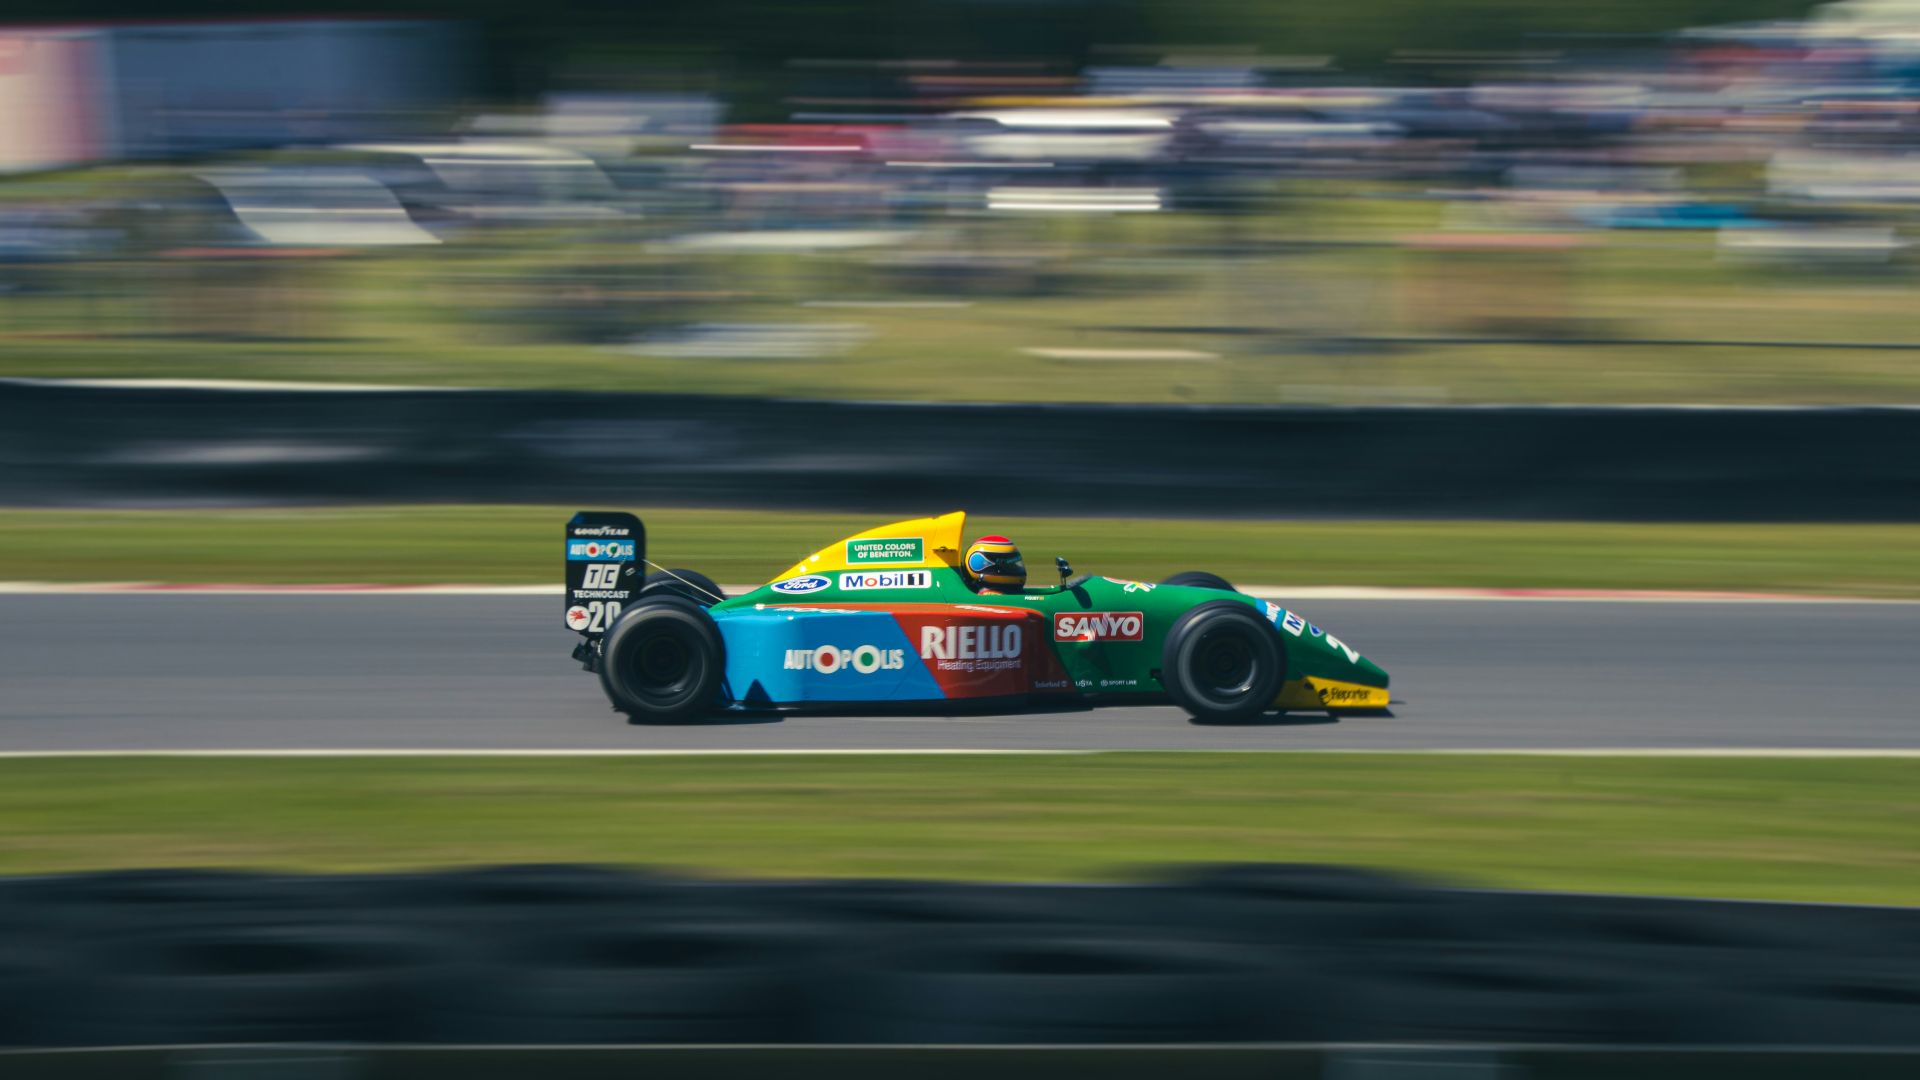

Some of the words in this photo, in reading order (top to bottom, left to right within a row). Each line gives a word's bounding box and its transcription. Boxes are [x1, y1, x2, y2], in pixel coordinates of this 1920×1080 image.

[570, 542, 633, 558] AUTOPOLIS
[784, 579, 818, 590] Ford
[845, 574, 904, 588] Mobil
[573, 590, 630, 599] TECHNOCAST
[1057, 616, 1140, 637] SANYO
[921, 625, 1022, 659] RIELLO
[784, 645, 904, 674] AUTOPOLIS
[938, 660, 974, 672] Heating
[976, 660, 1021, 671] Equipment
